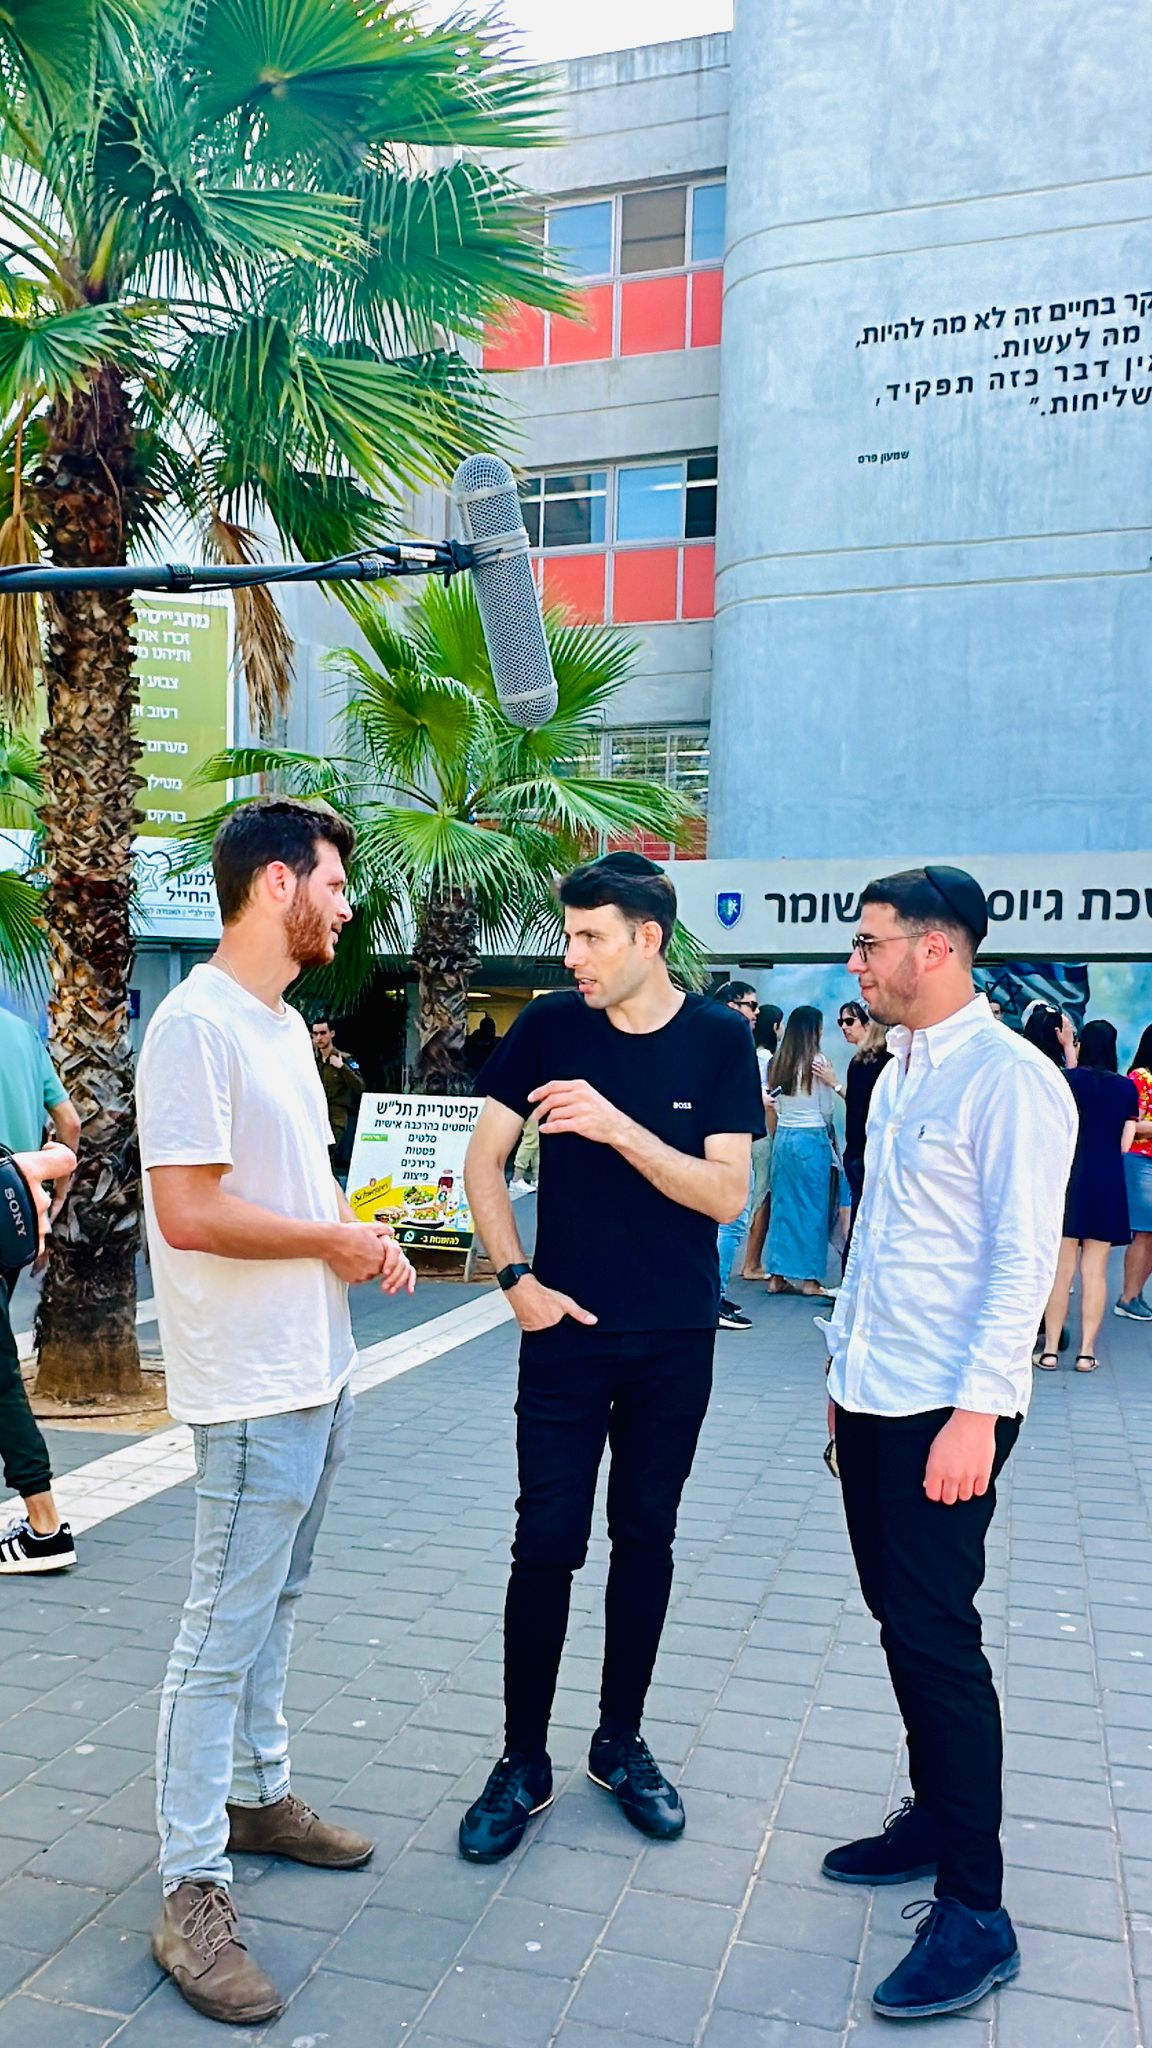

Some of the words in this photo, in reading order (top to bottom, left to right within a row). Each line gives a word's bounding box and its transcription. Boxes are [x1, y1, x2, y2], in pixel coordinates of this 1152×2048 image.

[974, 306, 1006, 331] לא
[1014, 304, 1043, 326] זה
[1050, 296, 1116, 322] בחיים
[855, 316, 924, 348] להיות,
[933, 314, 967, 336] מה
[993, 326, 1090, 359] לעשות.
[1102, 325, 1140, 347] מה
[1054, 359, 1109, 383] דבר
[1126, 354, 1152, 382] ין
[989, 368, 1038, 391] כזה
[875, 375, 974, 407] תפקיד,
[857, 454, 878, 464] פרס
[881, 450, 910, 464] שמעון
[137, 628, 159, 643] את
[163, 630, 190, 645] זכרו
[147, 675, 179, 689] צבוע
[147, 705, 178, 719] רטוב
[146, 809, 187, 824] בורקס
[177, 871, 215, 888] למען
[166, 886, 211, 904] החייל
[987, 888, 1063, 921] גיוס
[764, 892, 862, 923] שומר
[416, 1102, 479, 1122] קפיטריית
[374, 1119, 402, 1129] אישית
[404, 1121, 439, 1131] בהרכבה
[407, 1133, 438, 1143] סלטים
[405, 1146, 436, 1156] פסטות
[402, 1171, 429, 1181] פיצות
[4, 1187, 27, 1237] SONY
